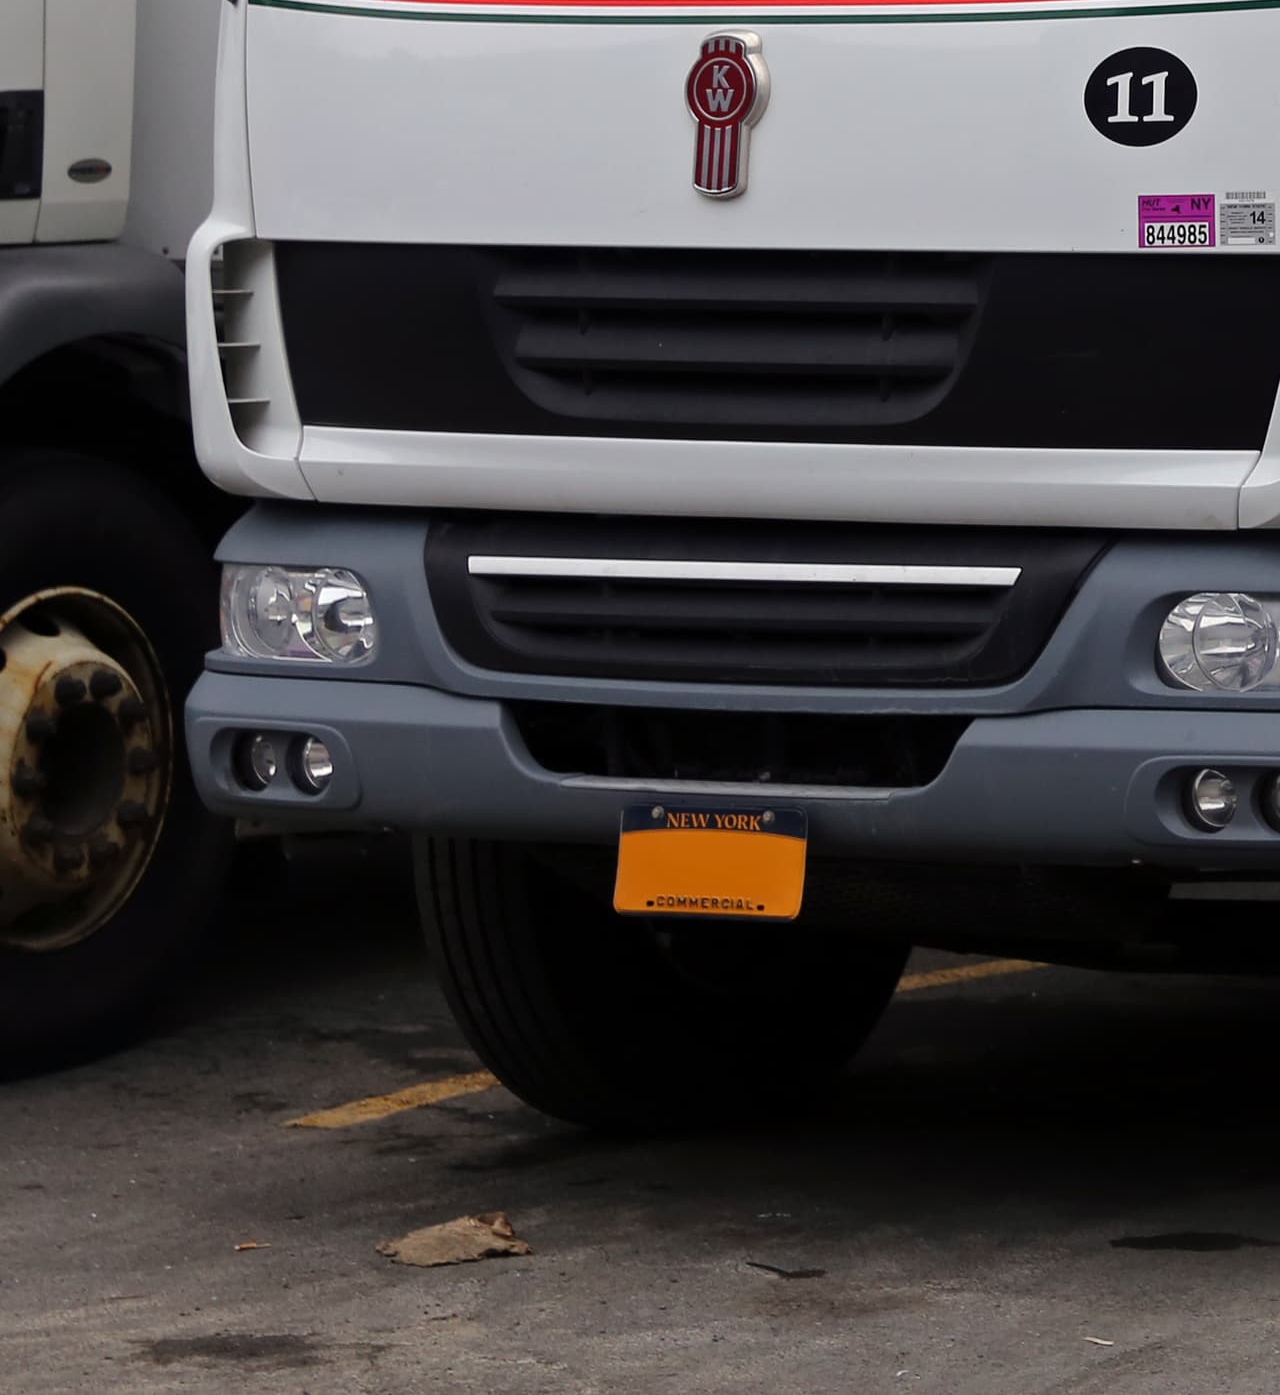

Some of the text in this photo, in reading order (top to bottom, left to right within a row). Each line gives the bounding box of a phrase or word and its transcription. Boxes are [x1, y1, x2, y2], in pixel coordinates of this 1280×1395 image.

[1106, 71, 1175, 123] 11
[1191, 198, 1211, 211] NY
[1249, 210, 1266, 224] 14
[1146, 224, 1207, 245] 844985
[667, 812, 761, 831] NEW YORK
[657, 895, 754, 911] COMMERCIAL
